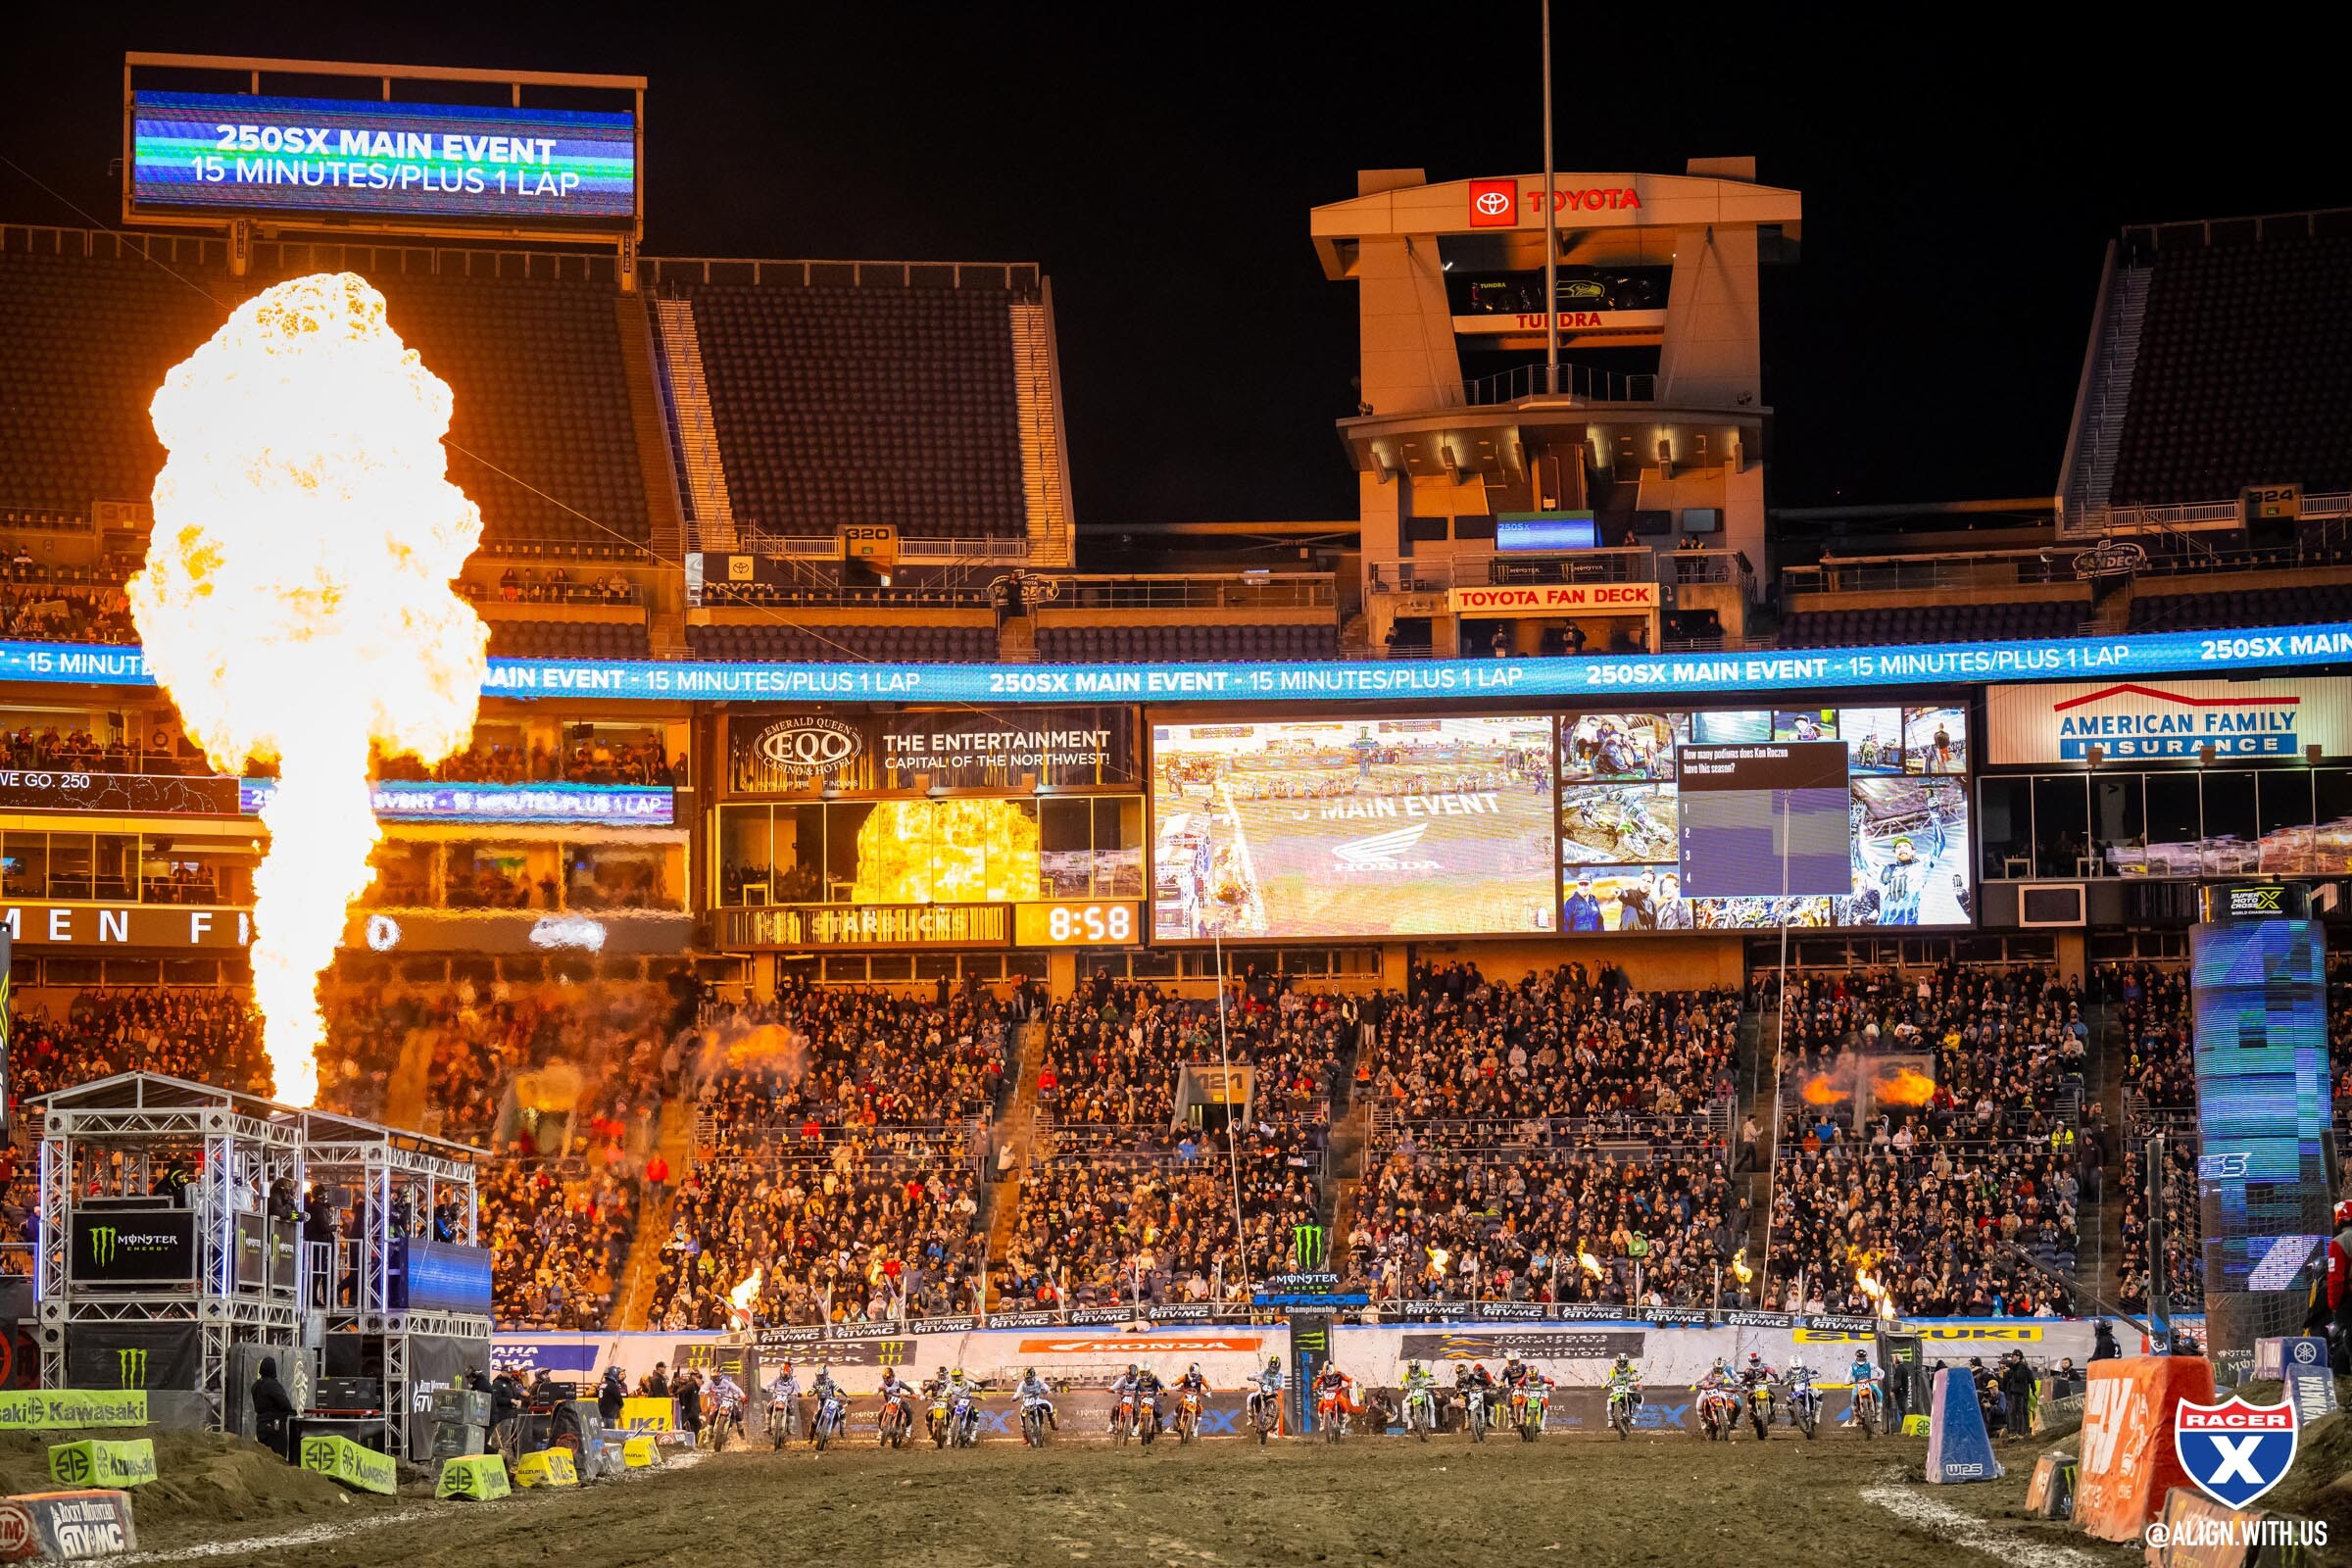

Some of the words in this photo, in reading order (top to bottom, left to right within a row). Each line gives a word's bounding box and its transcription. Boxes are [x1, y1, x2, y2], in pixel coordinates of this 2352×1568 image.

[216, 125, 329, 155] 250SX
[340, 129, 432, 159] MAIN
[443, 137, 557, 165] EVENT
[191, 156, 224, 182] 15
[236, 159, 484, 193] MINUTES/PLUS
[496, 170, 506, 193] 1
[519, 171, 580, 197] LAP
[1528, 189, 1642, 212] TOYOTA
[2248, 490, 2293, 504] 324
[846, 528, 890, 540] 320
[1460, 590, 1540, 607] TOYOTA
[1547, 590, 1585, 604] FAN
[1594, 588, 1649, 603] DECK
[2200, 637, 2284, 661] 250SX
[2291, 632, 2352, 655] MAIN
[27, 652, 51, 672] 15
[1586, 662, 1666, 684] 250SX
[1673, 662, 1740, 682] MAIN
[1746, 659, 1828, 680] EVENT
[1848, 657, 1874, 677] 15
[1881, 649, 2060, 676] MINUTES/PLUS
[2068, 649, 2077, 668] 1
[2082, 647, 2130, 666] LAP
[543, 668, 625, 689] EVENT
[646, 670, 669, 690] 15
[677, 670, 853, 692] MINUTES/PLUS
[859, 672, 868, 691] 1
[876, 672, 921, 692] LAP
[990, 672, 1068, 694] 250SX
[1076, 672, 1141, 693] MAIN
[1149, 672, 1229, 692] EVENT
[1250, 670, 1274, 690] 15
[1281, 668, 1454, 690] MINUTES/PLUS
[1461, 668, 1470, 688] 1
[1478, 666, 1523, 687] LAP
[764, 716, 813, 736] EMERALD
[816, 717, 853, 735] QUEEN
[2060, 713, 2193, 736] AMERICAN
[2205, 711, 2297, 733] FAMILY
[775, 733, 843, 764] EQC
[884, 734, 925, 753] THE
[931, 729, 1110, 751] ENTERTAINMENT
[2079, 737, 2279, 756] INSURANCE
[885, 755, 947, 769] CAPITAL
[951, 755, 972, 768] OF
[977, 755, 1005, 767] THE
[1010, 752, 1109, 766] NORTHWEST!
[1684, 749, 1695, 760] How
[1697, 750, 1713, 760] many
[1714, 749, 1739, 760] podiums
[1740, 749, 1754, 759] does
[1754, 748, 1766, 759] Ken
[1767, 747, 1788, 758] Roczen
[763, 758, 804, 775] CASINO
[815, 758, 855, 774] HOTEL
[1684, 764, 1697, 774] have
[1699, 763, 1710, 773] this
[1711, 762, 1735, 773] season?
[25, 774, 56, 788] GO.
[61, 774, 90, 788] 250
[626, 797, 661, 813] LAP
[1321, 796, 1396, 819] MAIN
[1404, 793, 1500, 816] EVENT
[1686, 827, 1690, 839] 2
[1686, 851, 1690, 860] 3
[1333, 859, 1444, 872] HONDA
[1686, 872, 1691, 883] 4
[811, 911, 967, 934] STARBUCKS
[1051, 906, 1129, 941] 8:58
[1198, 1072, 1243, 1090] 121
[118, 1234, 178, 1245] MONSTER
[1276, 1273, 1339, 1285] MONSTER
[1286, 1305, 1337, 1314] Championship
[49, 1401, 144, 1421] Kawasaki
[1946, 1464, 1984, 1476] WPS
[59, 1501, 80, 1523] ROCKY
[80, 1501, 116, 1522] MOUNTAIN
